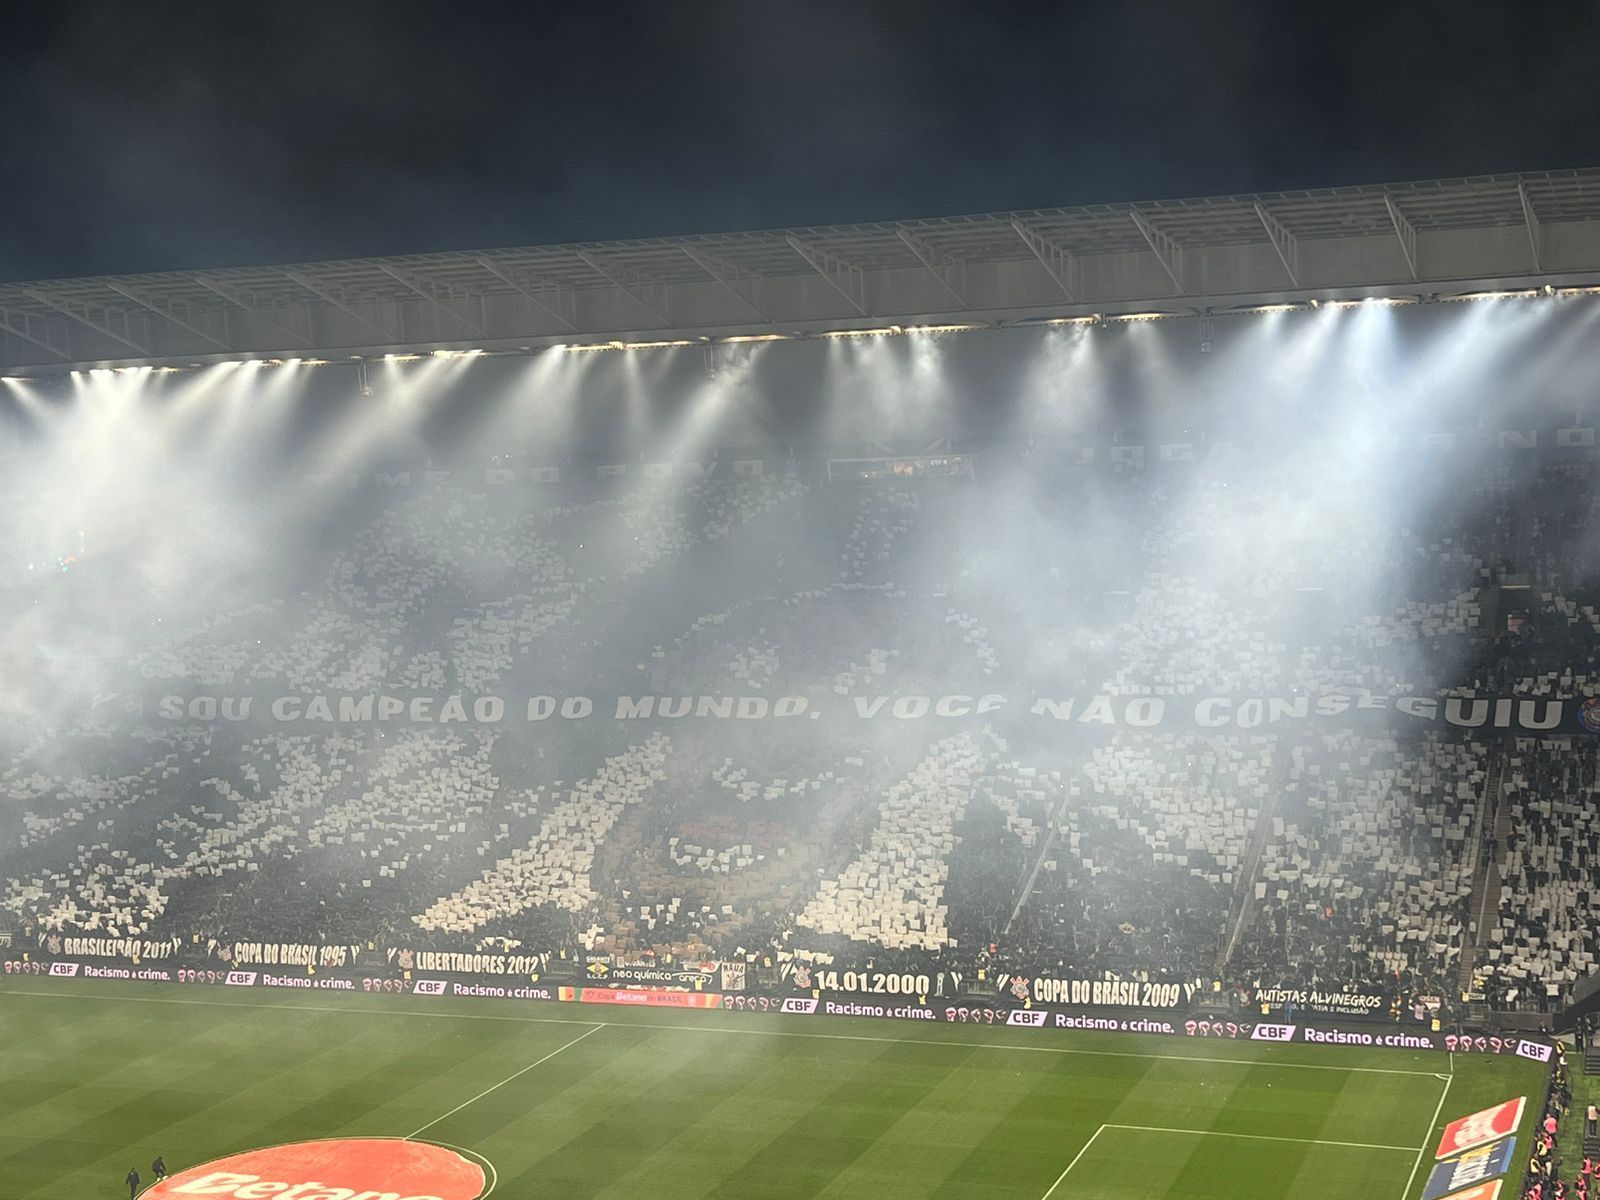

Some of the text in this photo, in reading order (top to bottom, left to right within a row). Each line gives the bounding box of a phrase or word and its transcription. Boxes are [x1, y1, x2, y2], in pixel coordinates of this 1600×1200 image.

[158, 696, 253, 721] SOU
[272, 694, 504, 723] CAMPEÃO
[527, 695, 592, 721] DO
[615, 695, 821, 720] MUNDO.
[1195, 695, 1563, 730] CONSEGUIU
[143, 940, 172, 958] 2011
[235, 942, 347, 967] COPA DO BRASIL 1995
[53, 964, 74, 975] CBF
[416, 952, 538, 975] LIBERTADORES 2012
[84, 967, 129, 978] Racismo
[138, 969, 171, 980] crime.
[230, 973, 251, 983] CBF
[613, 970, 632, 978] neo
[634, 970, 672, 981] química
[263, 975, 311, 987] Racismo
[320, 977, 355, 989] crime.
[418, 982, 440, 993] CBF
[814, 971, 930, 995] 14.01.2000
[454, 983, 505, 997] Racismo
[514, 987, 551, 999] crime.
[1034, 978, 1180, 1007] COPA DO BRASIL 2009
[1255, 989, 1307, 1003] AUTISTAS
[1310, 990, 1382, 1008] ALVINEGROS
[787, 1001, 811, 1011] CBF
[826, 1002, 883, 1016] Racismo
[894, 1005, 936, 1019] crime.
[1013, 1012, 1039, 1024] CBF
[1055, 1014, 1117, 1030] Racismo
[1130, 1018, 1175, 1033] crime.
[1258, 1026, 1287, 1038] CBF
[1305, 1028, 1372, 1045] Racismo
[1385, 1032, 1434, 1048] crime.
[1521, 1043, 1545, 1059] CBF
